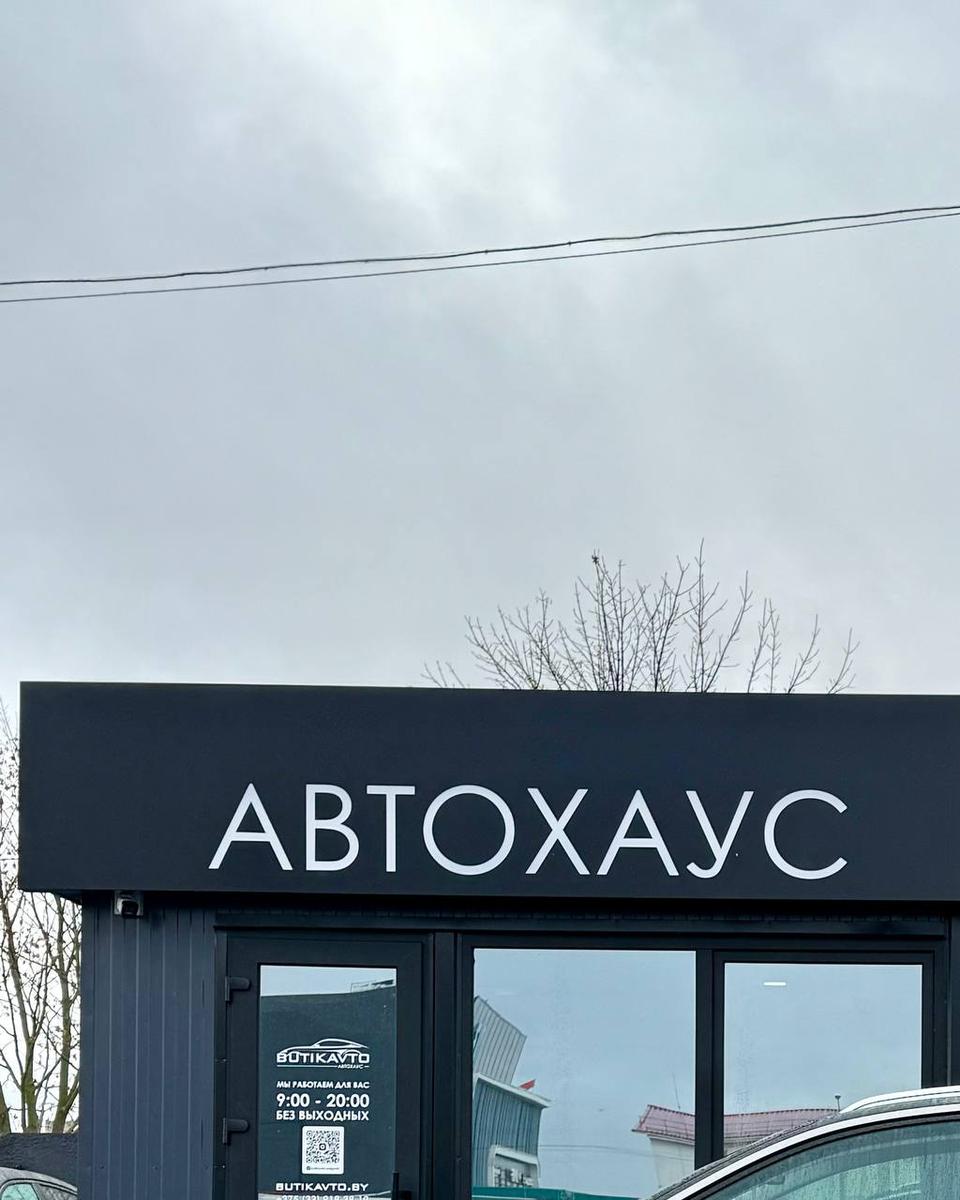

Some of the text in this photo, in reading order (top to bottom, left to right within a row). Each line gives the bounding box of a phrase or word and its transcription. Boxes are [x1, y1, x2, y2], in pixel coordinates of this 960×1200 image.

[208, 782, 849, 881] АВТОХАУС
[276, 1053, 370, 1063] BUTIKAVTO
[334, 1081, 352, 1089] ДЛЯ
[276, 1093, 310, 1107] 9:00
[326, 1093, 370, 1108] 20:00
[276, 1110, 369, 1121] БЕЗ ВЫХОДНЫХ
[275, 1183, 369, 1191] BUTIKAVTO.BY
